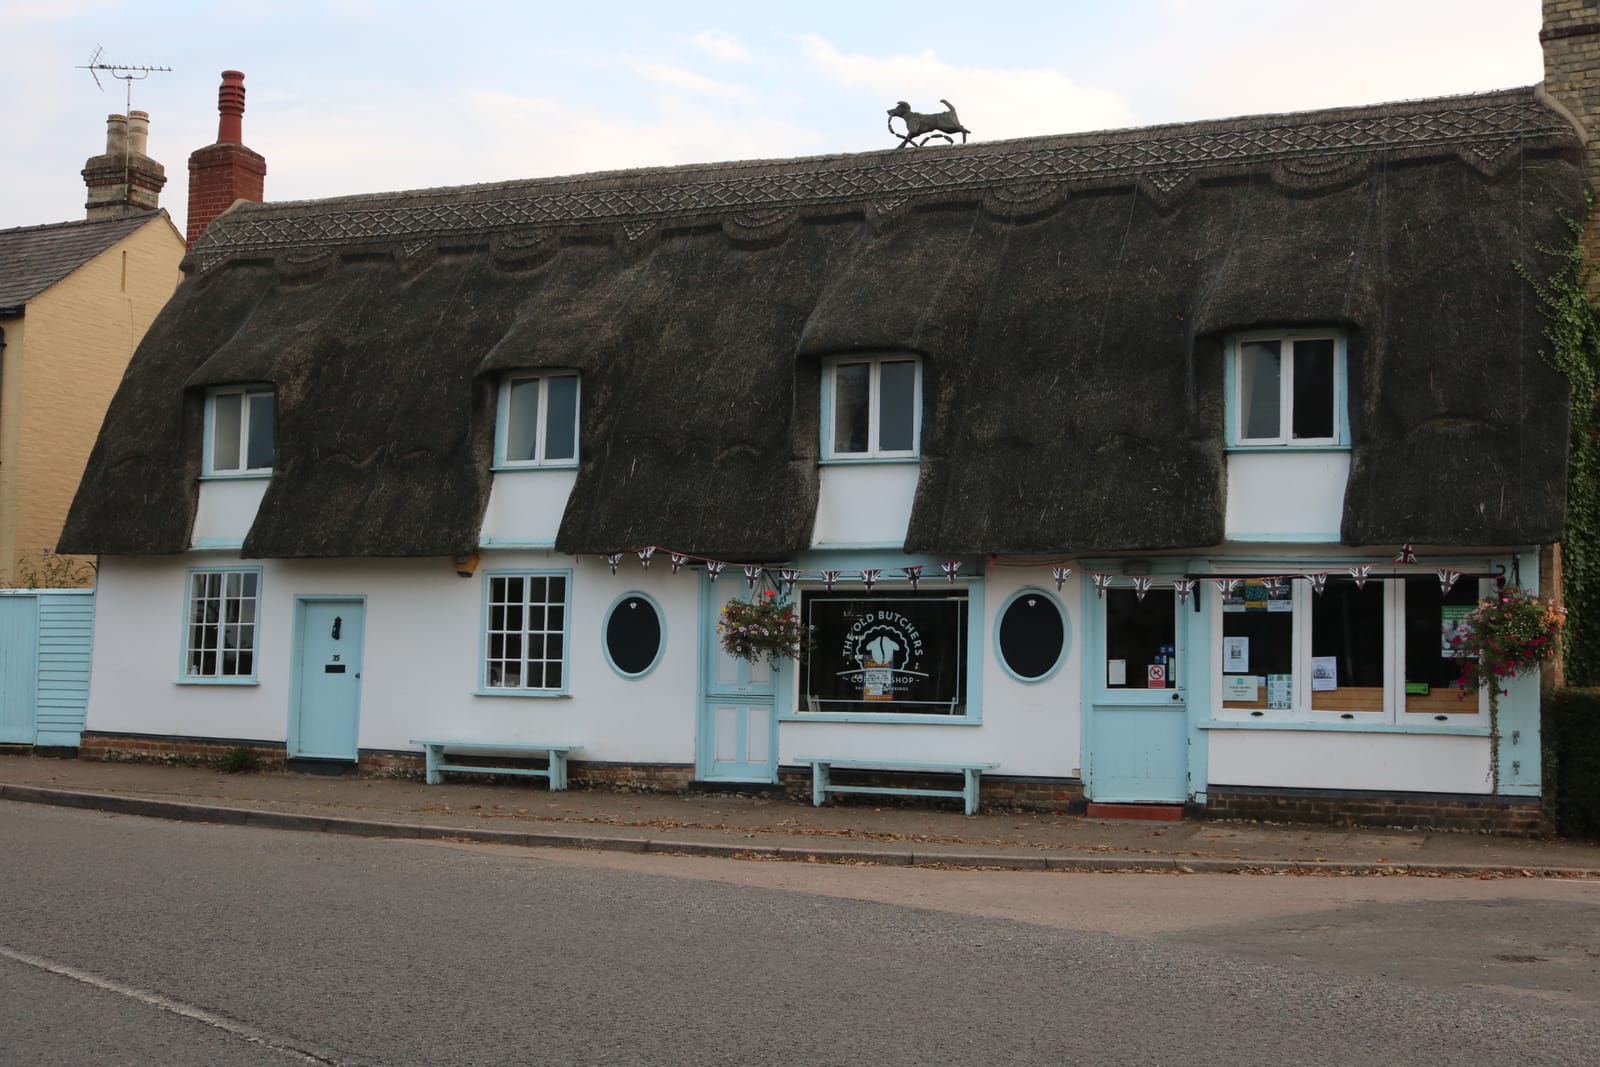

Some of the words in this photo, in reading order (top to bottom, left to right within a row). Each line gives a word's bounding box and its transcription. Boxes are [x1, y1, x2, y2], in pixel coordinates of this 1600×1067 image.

[842, 632, 855, 657] THE
[853, 613, 874, 632] OLD
[878, 610, 924, 656] BUTCHERS
